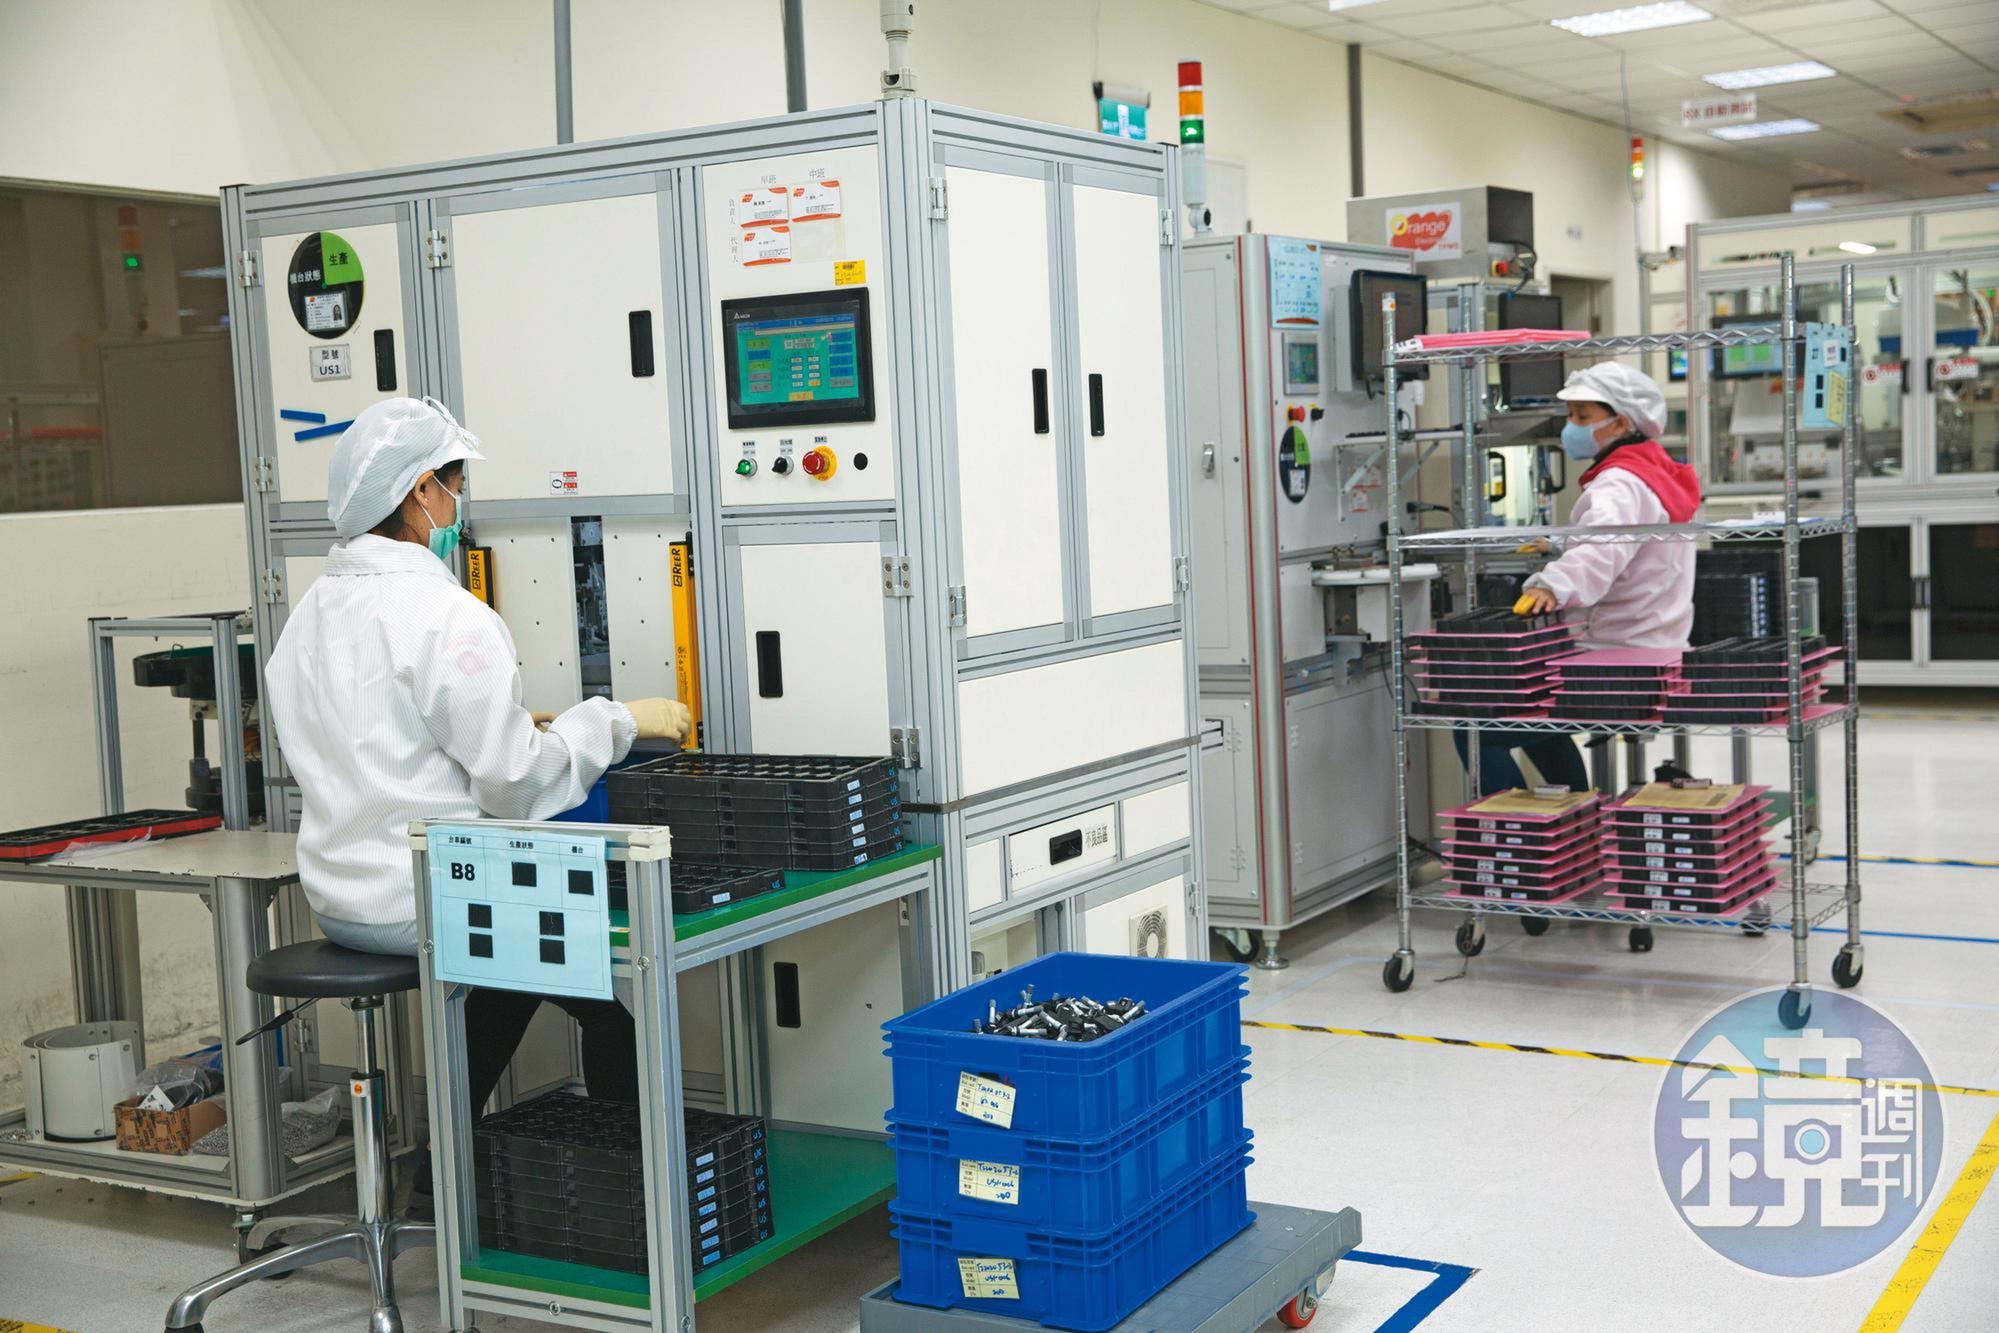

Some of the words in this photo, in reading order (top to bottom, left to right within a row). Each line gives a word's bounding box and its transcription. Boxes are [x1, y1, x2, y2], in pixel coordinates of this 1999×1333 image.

[809, 168, 825, 179] 中班
[1391, 214, 1446, 236] Orange
[329, 252, 348, 265] 生產
[290, 269, 321, 284] 機台狀態
[322, 350, 339, 360] 型號
[319, 365, 341, 375] US1
[448, 836, 472, 845] 台車編號
[509, 841, 534, 850] 生產狀態
[571, 846, 584, 854] 機台
[450, 862, 476, 881] B8
